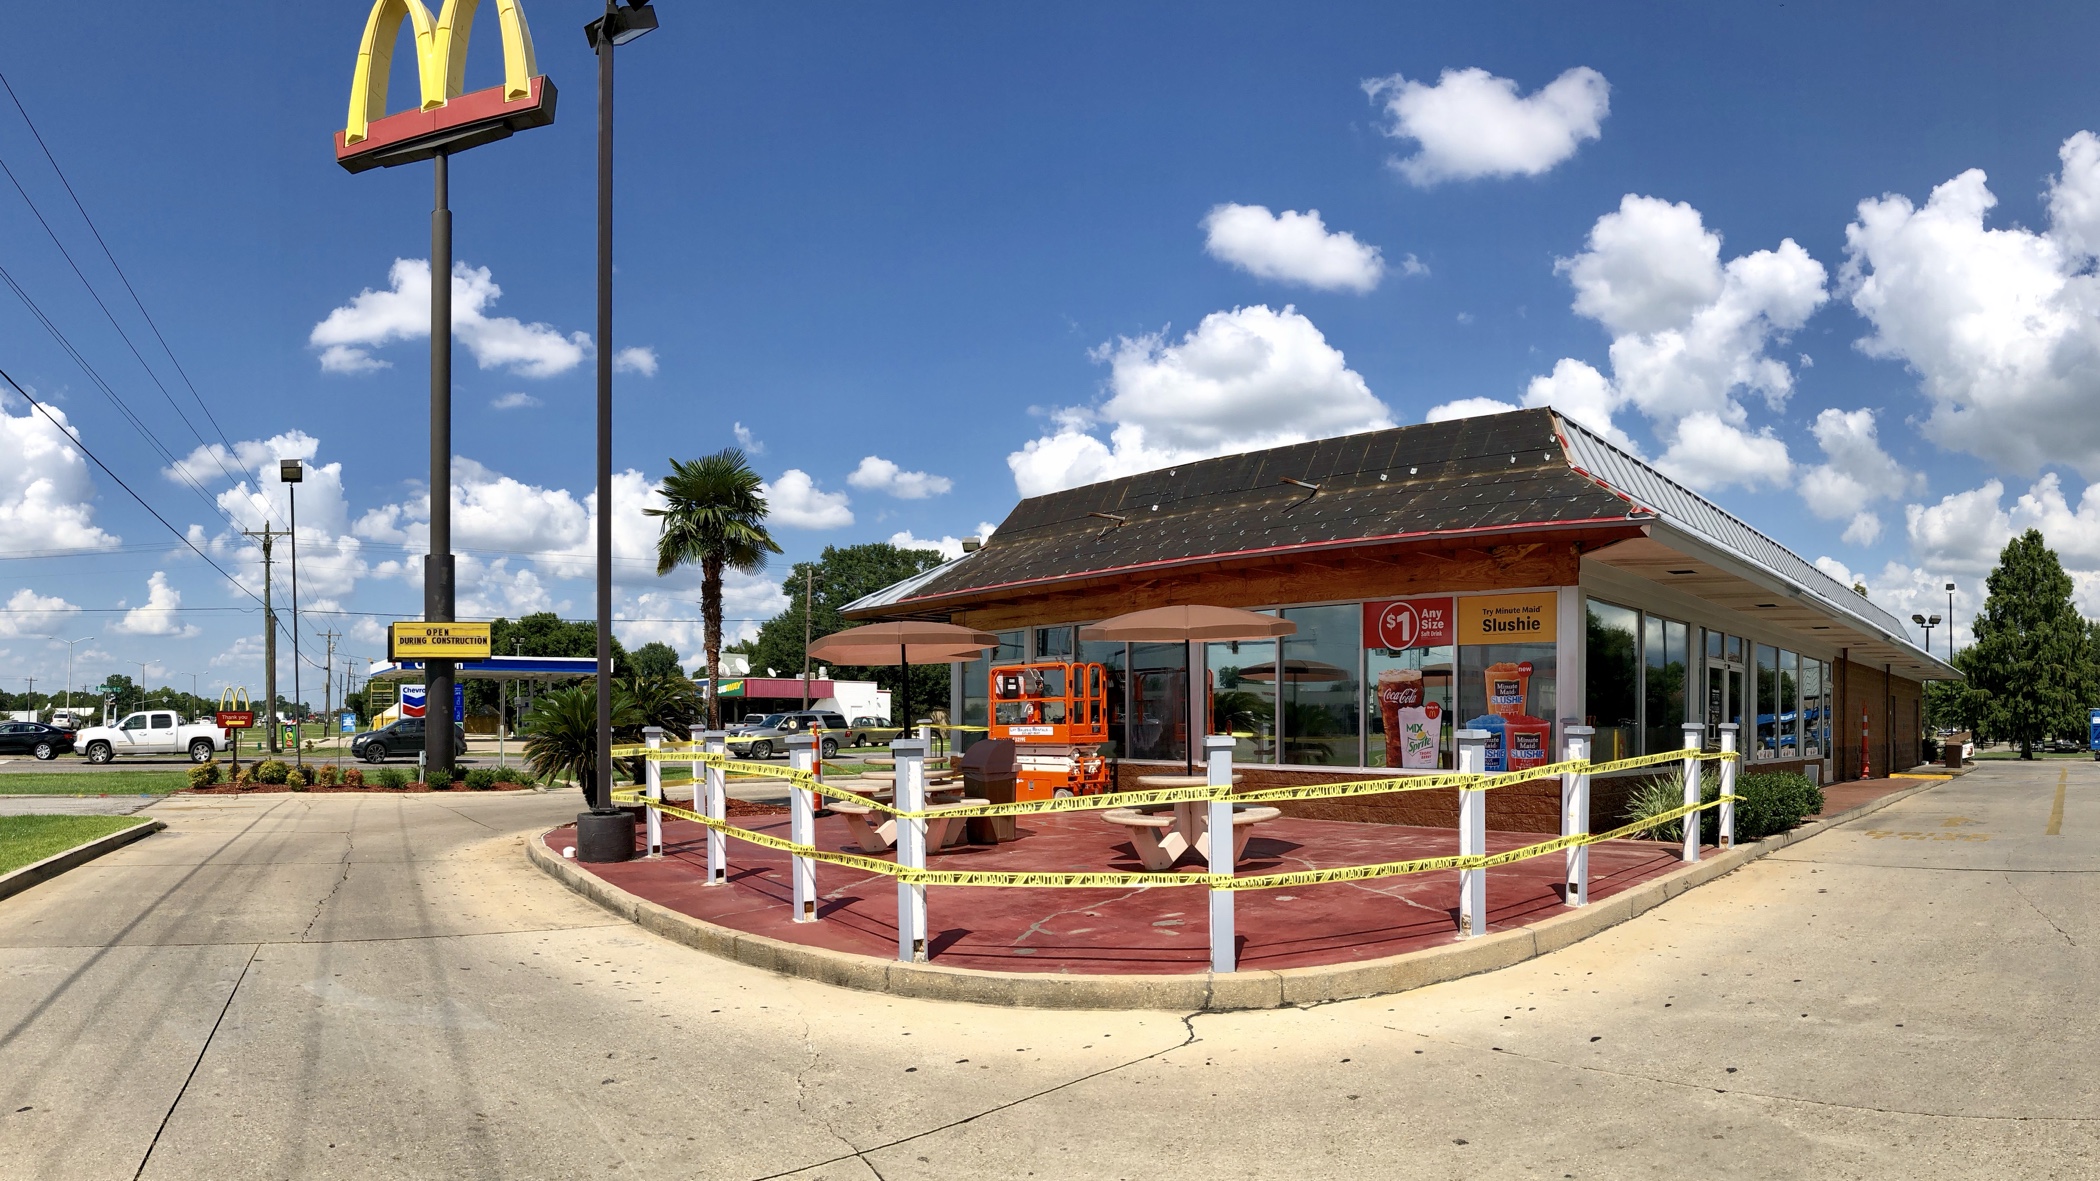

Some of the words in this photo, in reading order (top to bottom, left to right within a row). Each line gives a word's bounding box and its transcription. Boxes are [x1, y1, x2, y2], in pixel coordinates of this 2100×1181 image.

[1421, 609, 1443, 620] Any
[1482, 608, 1494, 616] Try
[1386, 611, 1410, 641] $1
[1421, 619, 1444, 630] Size
[1482, 616, 1541, 632] Slushie
[402, 686, 426, 694] Chevro
[718, 680, 744, 694] UBWAY
[1383, 688, 1418, 704] Coca-Cola
[1491, 696, 1524, 704] SLUSHIE
[1406, 724, 1423, 733] MIX
[1408, 737, 1431, 753] Sprite
[1511, 750, 1544, 758] SLUSHIE
[1310, 785, 1342, 796] CAUTION
[1358, 782, 1388, 792] CUIDADO
[1402, 778, 1432, 789] CAUTION
[999, 803, 1035, 814] CUIDADO
[1055, 797, 1093, 810] CAUTION
[1112, 793, 1149, 805] CUIDADO
[1170, 788, 1209, 800] CAUTION
[1283, 873, 1316, 884] CAUTION
[1332, 868, 1364, 880] CUIDADO
[1380, 863, 1409, 874] CAUTION
[1423, 858, 1452, 869] CUIDADO
[918, 874, 954, 883] CAUTION
[973, 874, 1009, 884] CUIDADO
[1028, 874, 1065, 885] CAUTION
[1084, 875, 1122, 885] CUIDADO
[1142, 875, 1179, 884] CAUTION
